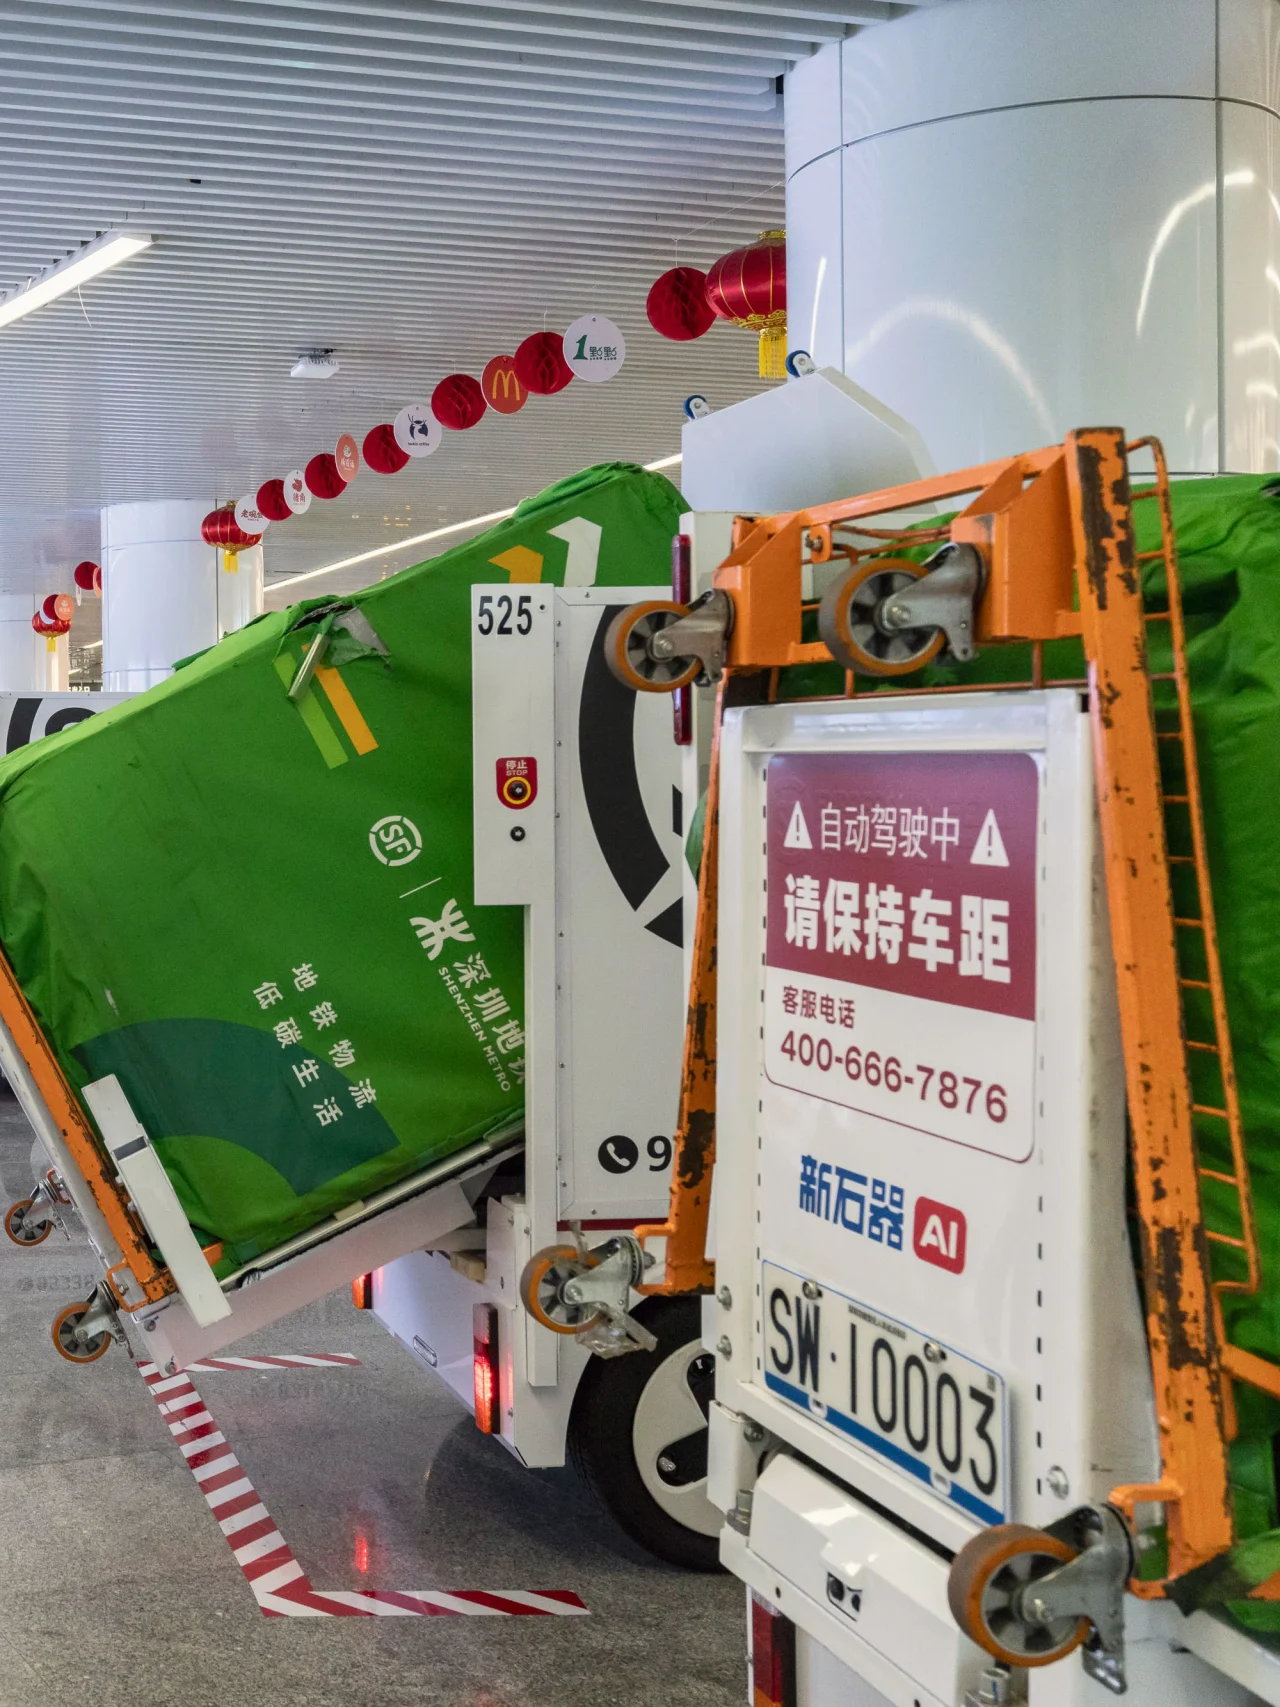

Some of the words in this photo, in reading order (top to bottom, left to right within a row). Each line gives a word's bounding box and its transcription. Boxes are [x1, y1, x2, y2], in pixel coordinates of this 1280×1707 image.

[477, 595, 532, 635] 525
[505, 759, 528, 770] 停止
[820, 802, 960, 861] 自动驾驶中
[783, 873, 1012, 984] 请保持车距
[252, 981, 344, 1127] 低碳生活
[291, 962, 377, 1109] 地铁物流
[438, 966, 487, 1043] SHENZHEN
[483, 1044, 511, 1092] METRO
[782, 985, 856, 1030] 客服电话
[780, 1030, 1009, 1124] 400-666-7876
[647, 1135, 672, 1172] 9
[799, 1154, 905, 1251] 新石器
[919, 1213, 958, 1260] AI
